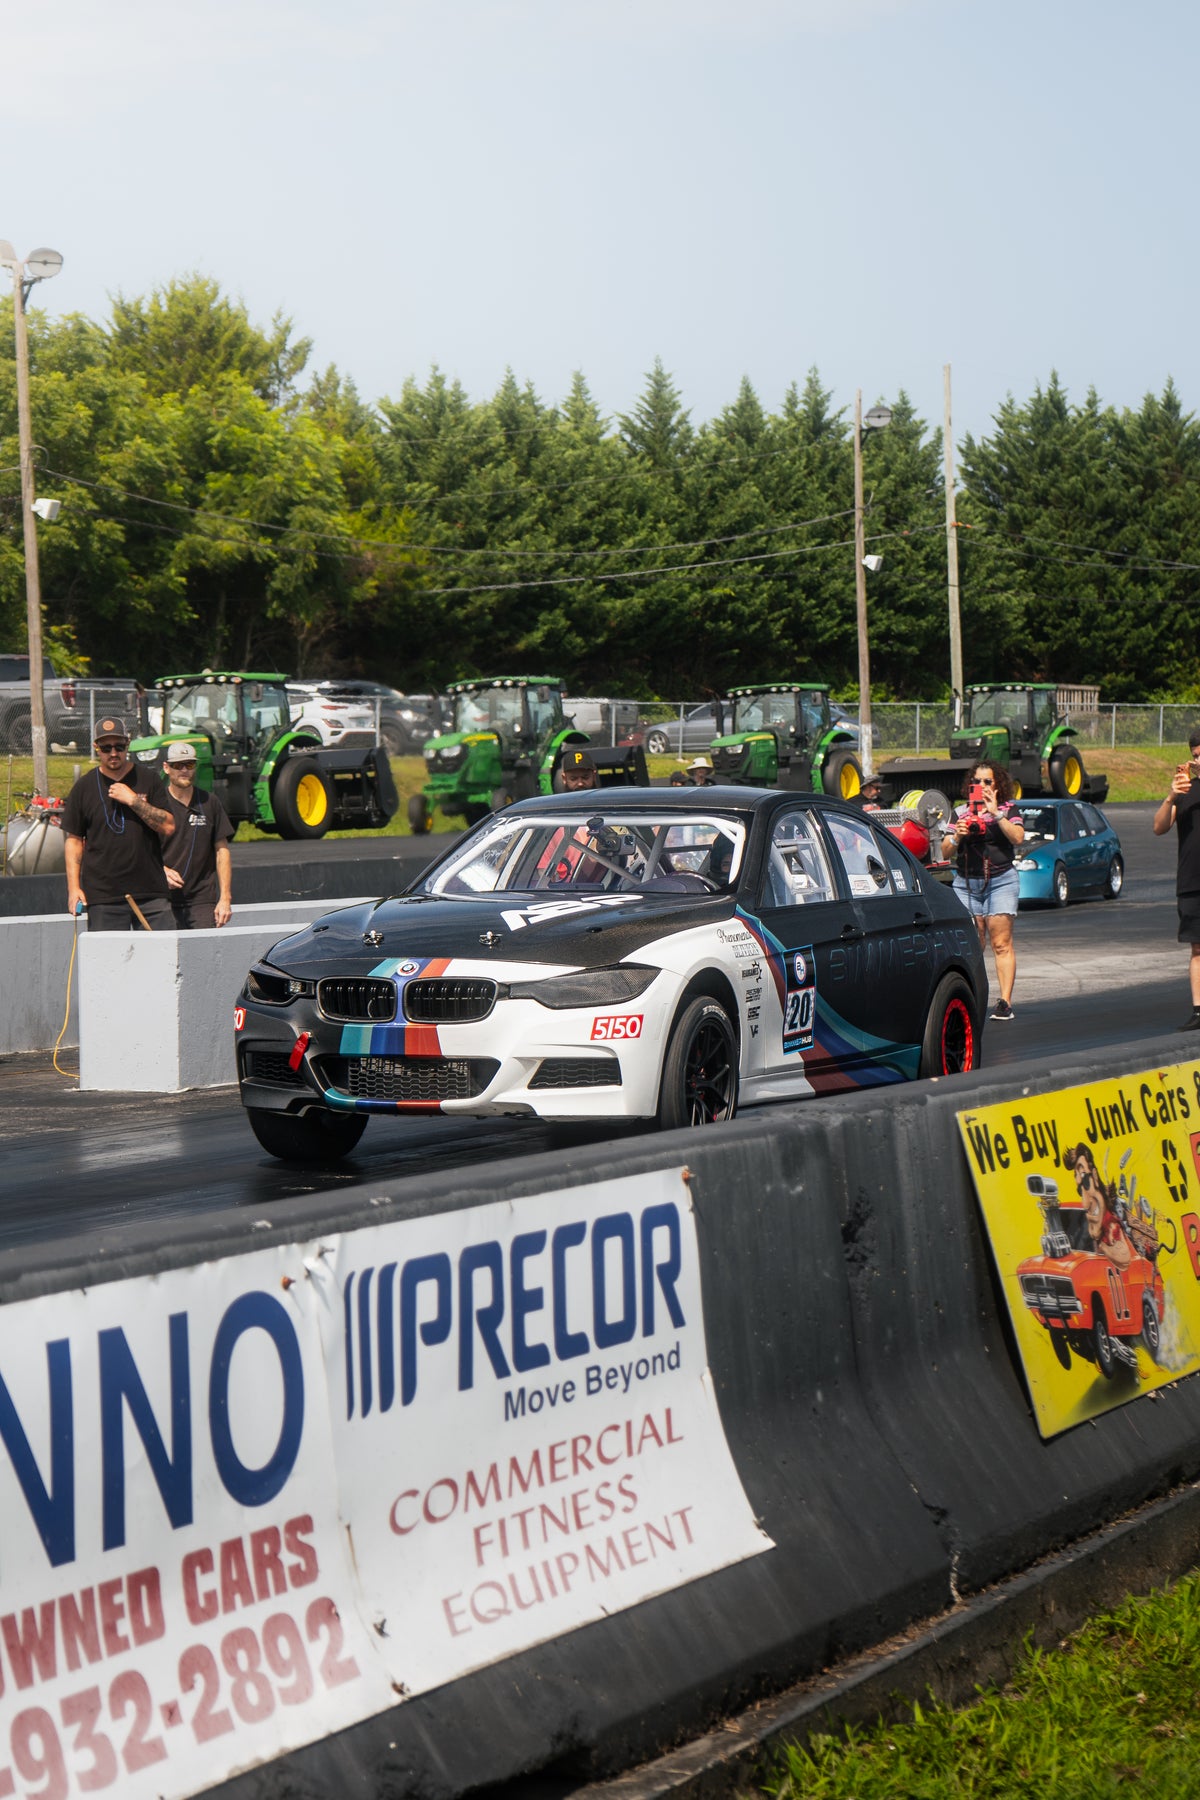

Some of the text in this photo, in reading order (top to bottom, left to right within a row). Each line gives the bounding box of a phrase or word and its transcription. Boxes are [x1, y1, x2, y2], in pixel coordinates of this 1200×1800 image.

[574, 752, 583, 764] P
[593, 1016, 641, 1039] 5150
[788, 991, 811, 1031] 20
[966, 1121, 1010, 1176] We
[1011, 1114, 1061, 1168] Buy
[1085, 1089, 1139, 1145] Junk
[1139, 1082, 1191, 1130] Cars
[504, 1341, 682, 1422] Move Beyond
[389, 1406, 684, 1537] COMMERCIAL
[472, 1472, 639, 1567] FITNESS
[0, 1514, 319, 1700] WNED CARS
[441, 1506, 697, 1638] EQUIPMENT
